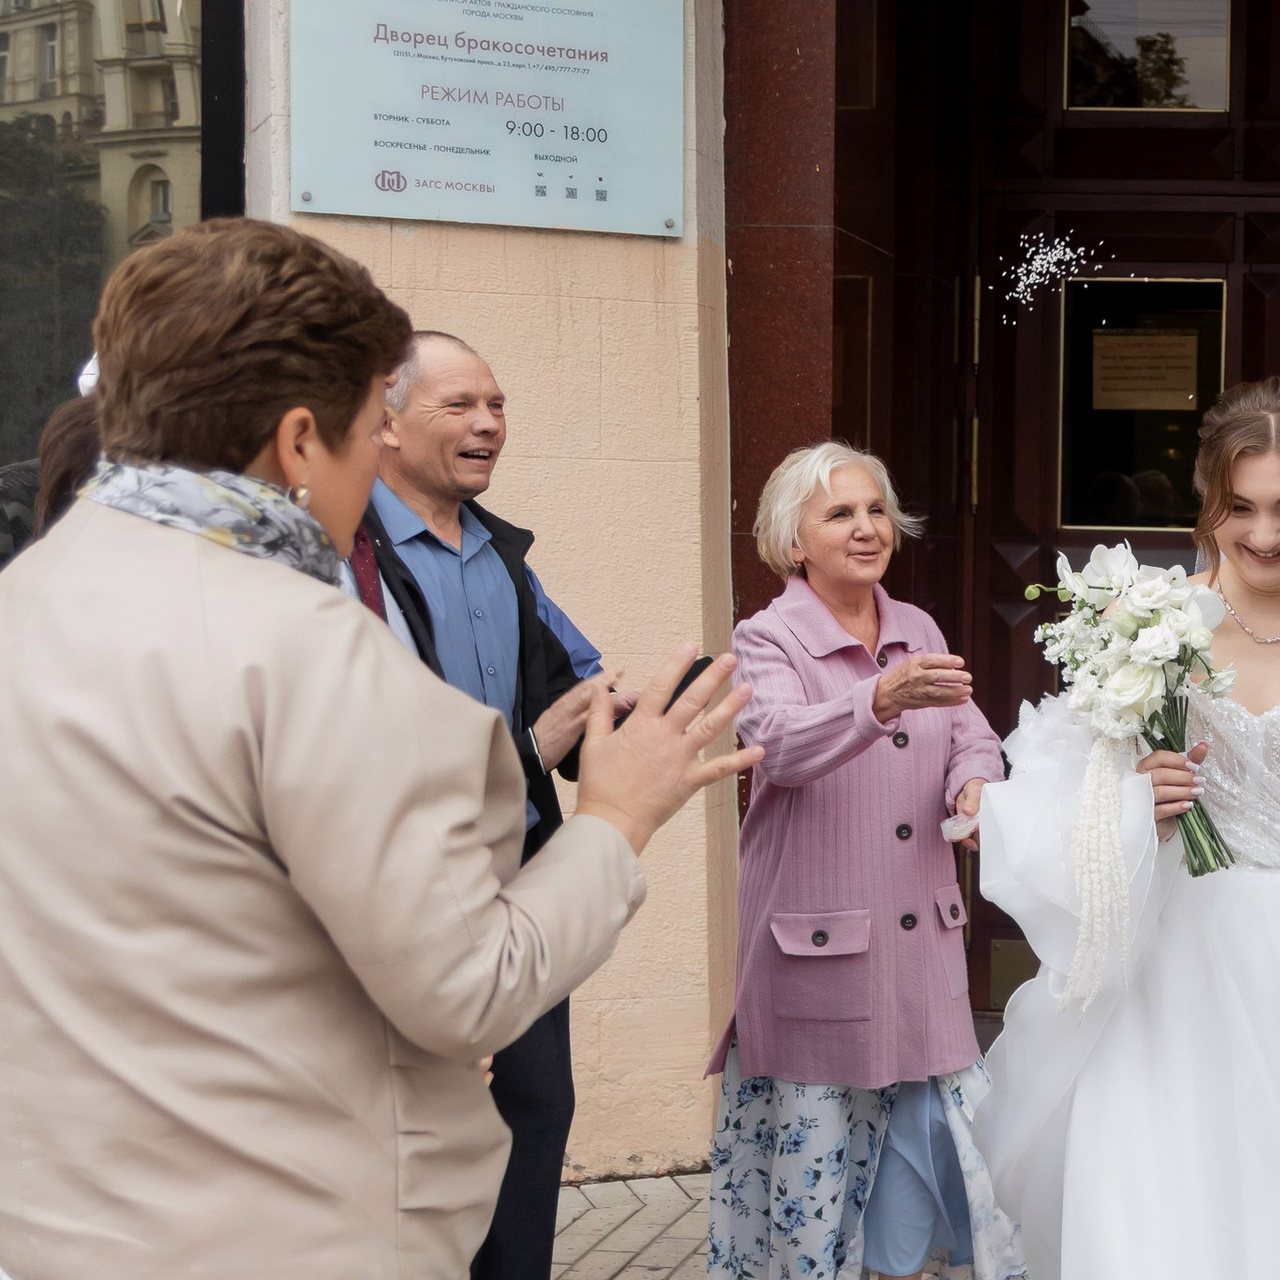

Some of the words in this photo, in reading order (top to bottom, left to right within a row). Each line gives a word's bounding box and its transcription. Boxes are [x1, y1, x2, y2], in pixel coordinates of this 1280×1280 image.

[462, 9, 491, 18] ГОРОДА
[492, 12, 524, 21] МОСКВЫ
[468, 0, 491, 7] АКТОВ
[494, 1, 550, 13] ГРАЖДАНСКОГО
[551, 7, 594, 18] СОСТОЯНИЯ
[373, 23, 449, 50] Дворец
[455, 31, 609, 63] бракосочетания
[421, 84, 489, 105] РЕЖИМ
[495, 91, 564, 111] РАБОТЫ
[373, 114, 410, 123] ВТОРНИК
[416, 117, 450, 126] СУББОТА
[505, 120, 545, 138] 9:00
[563, 125, 608, 143] 18:00
[373, 140, 428, 151] ВОСКРЕСЕНЬЕ
[433, 145, 491, 156] ПОНЕДЕЛЬНИК
[534, 153, 578, 163] ВЫХОДНОЙ
[414, 179, 442, 189] ЗАГС
[444, 182, 495, 193] МОСКВЫ
